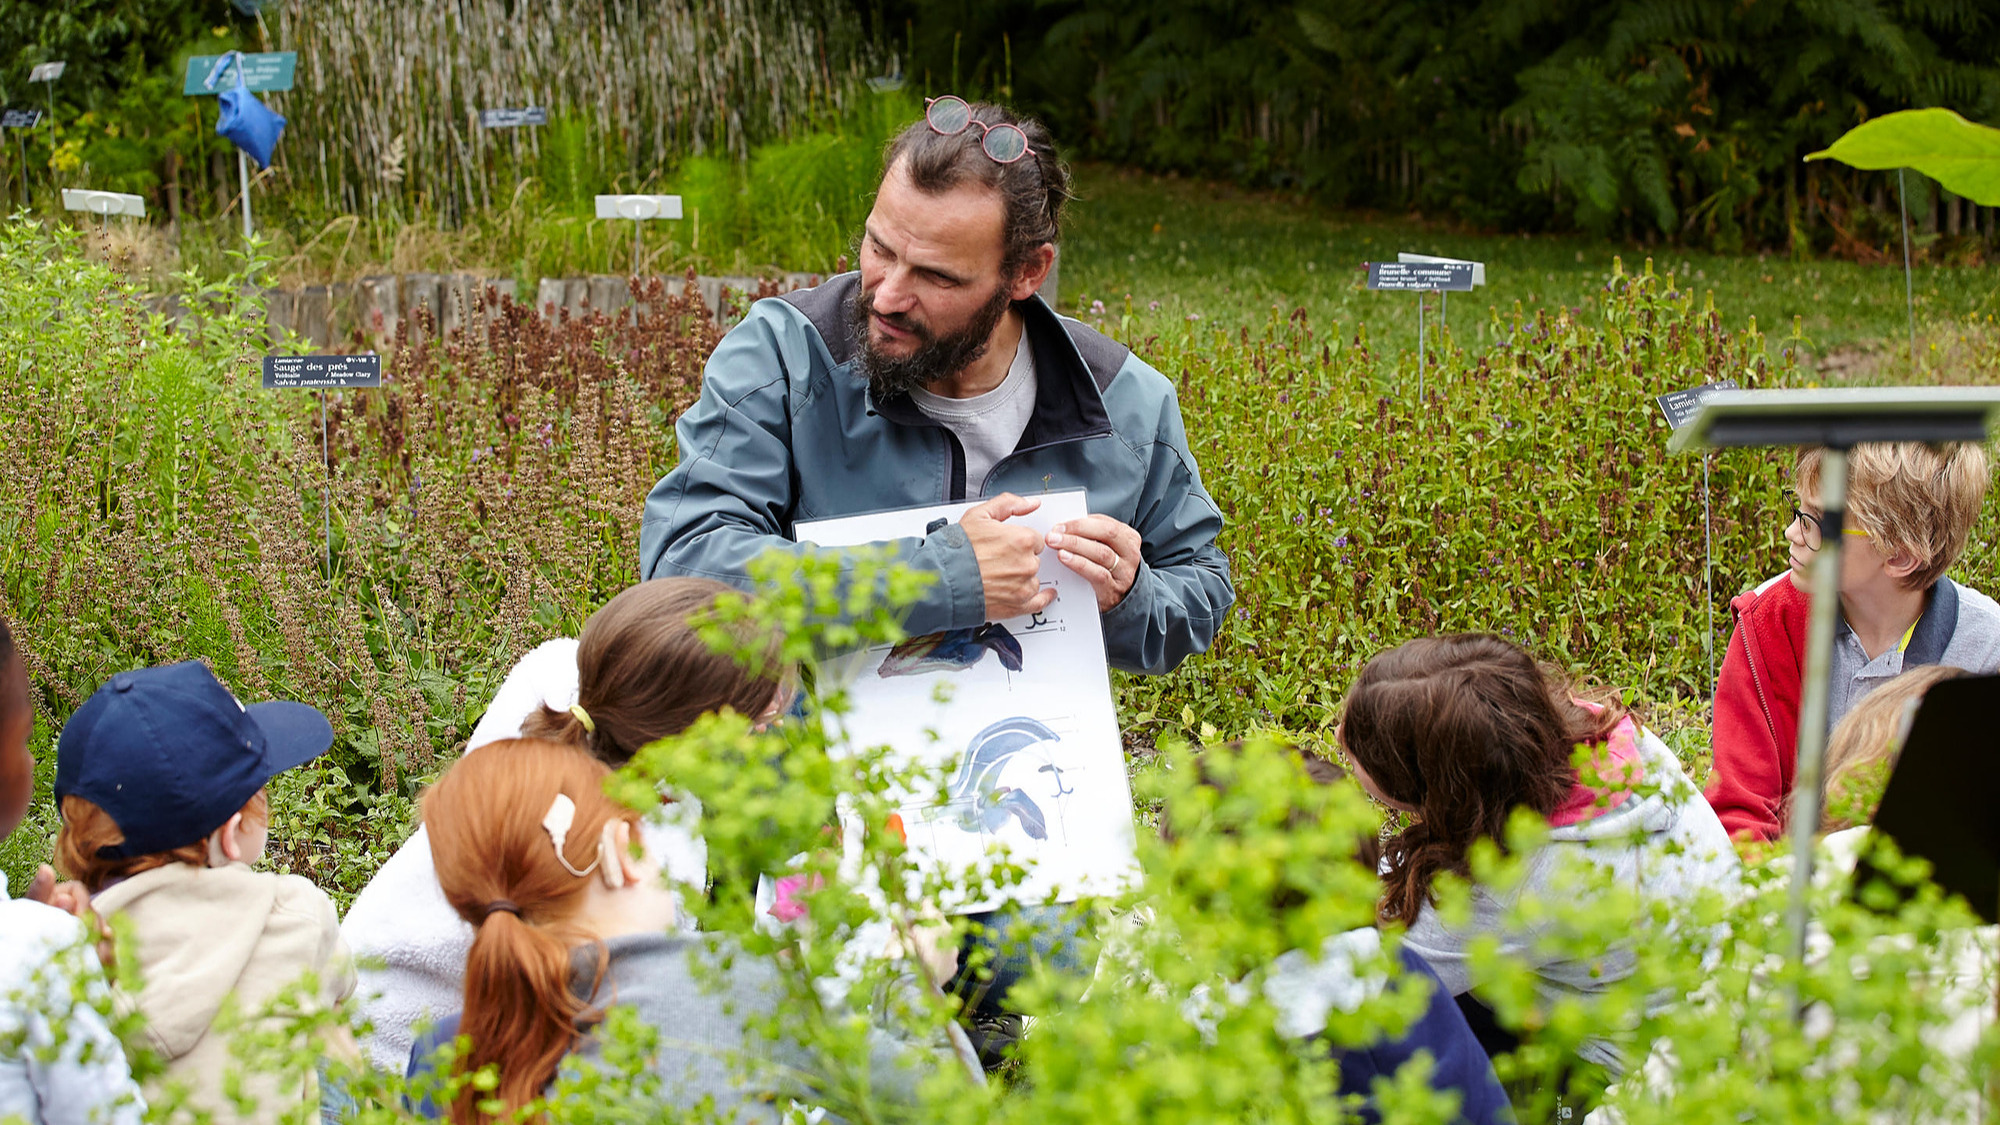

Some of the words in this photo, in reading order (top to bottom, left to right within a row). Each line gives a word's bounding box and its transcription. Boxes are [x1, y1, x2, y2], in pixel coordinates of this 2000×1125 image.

[274, 364, 302, 372] Sauge
[306, 363, 323, 371] des
[328, 363, 348, 372] prés
[1669, 397, 1696, 410] Lamier
